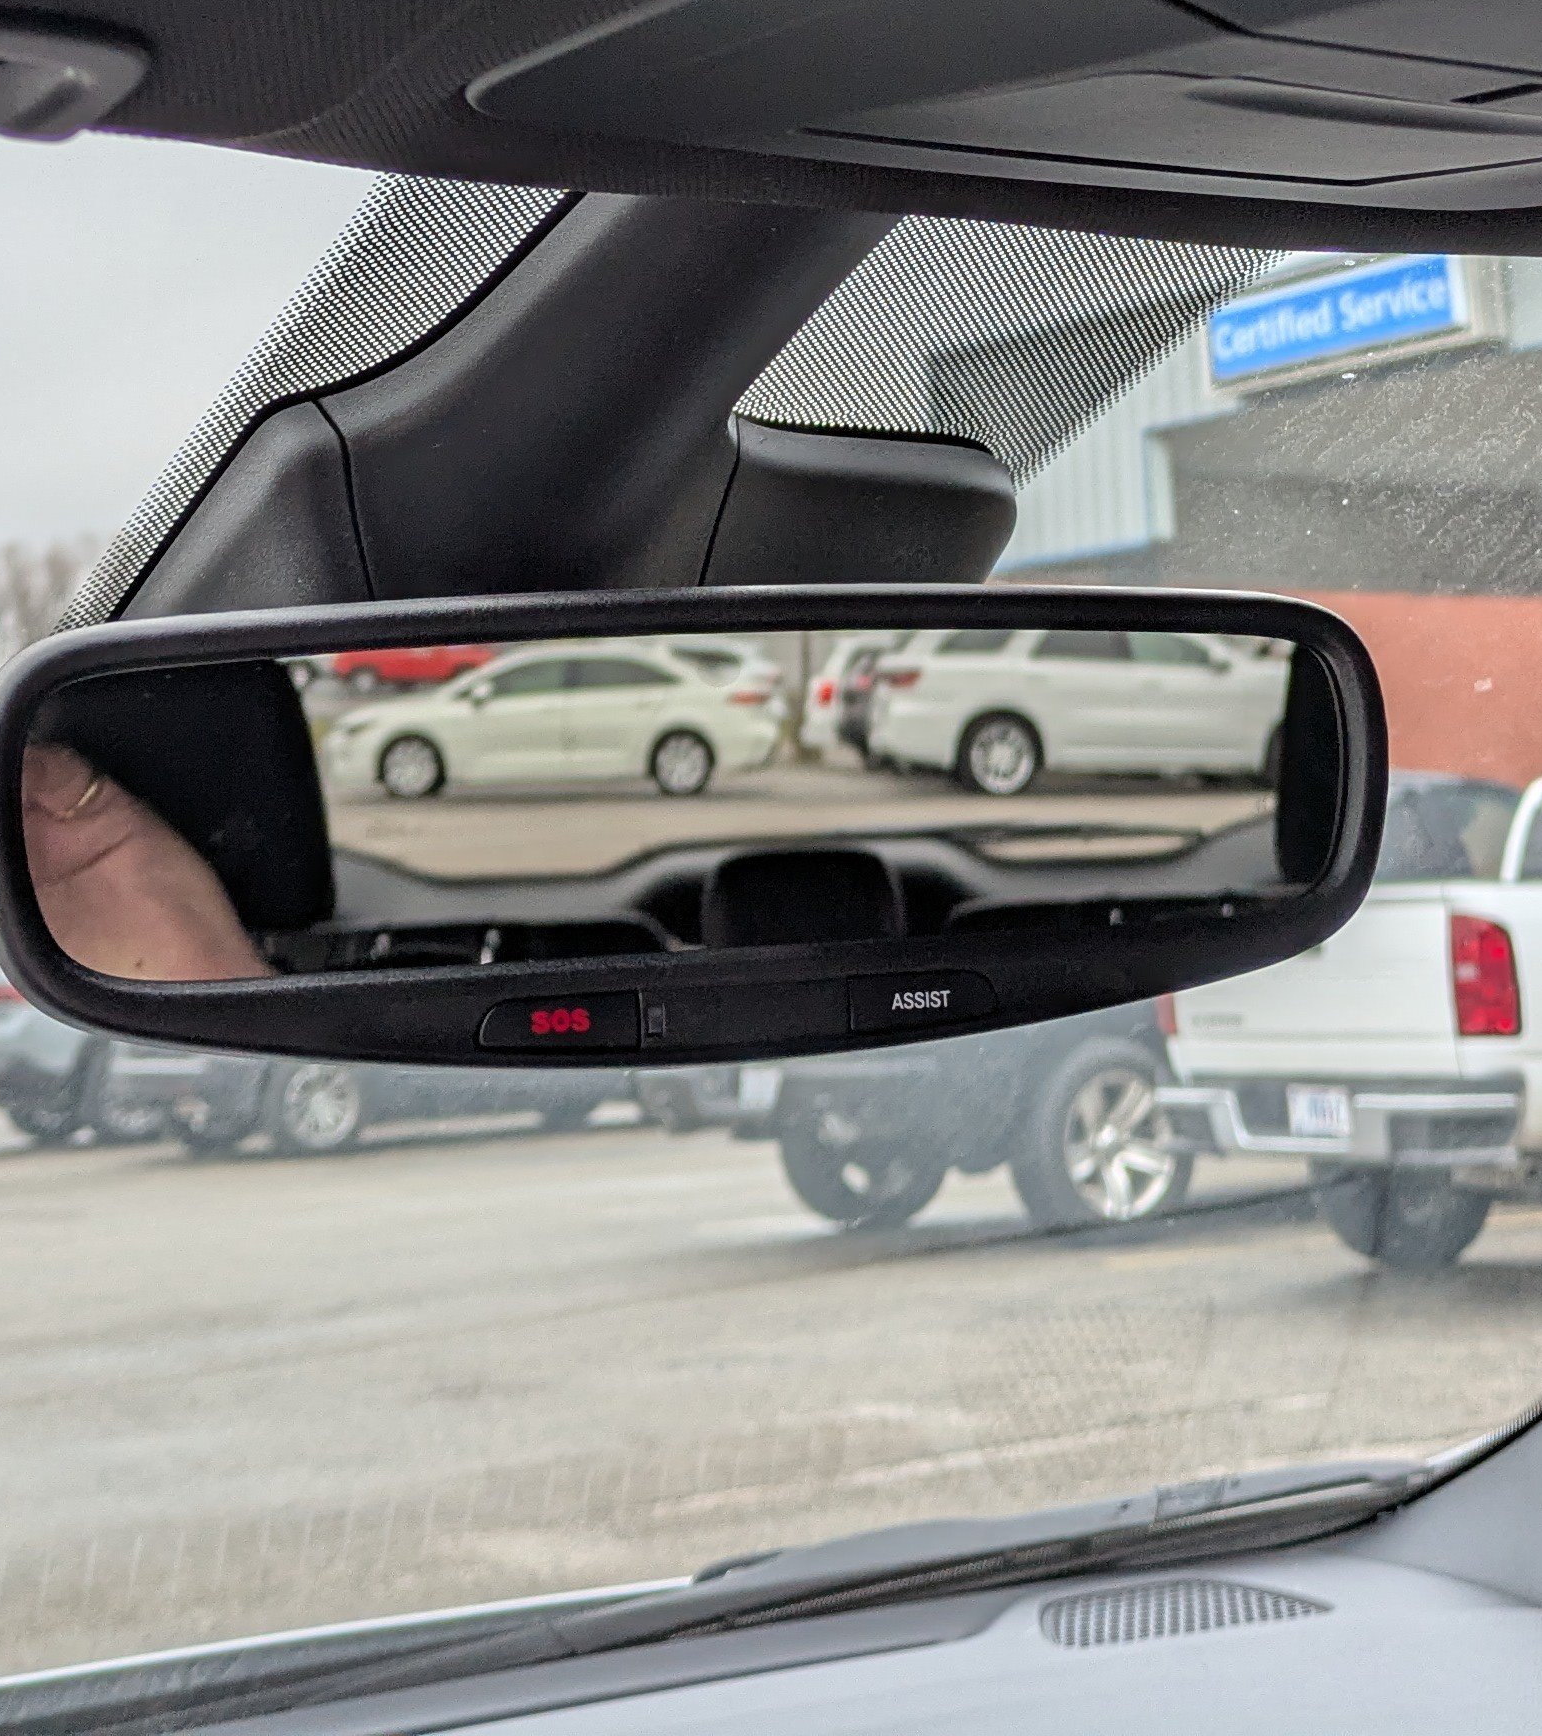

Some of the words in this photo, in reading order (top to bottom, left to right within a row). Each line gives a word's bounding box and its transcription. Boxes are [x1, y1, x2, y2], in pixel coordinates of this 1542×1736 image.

[1215, 300, 1332, 359] Certified
[1340, 277, 1446, 331] Service
[890, 989, 951, 1011] ASSIST
[529, 1007, 592, 1035] SOS
